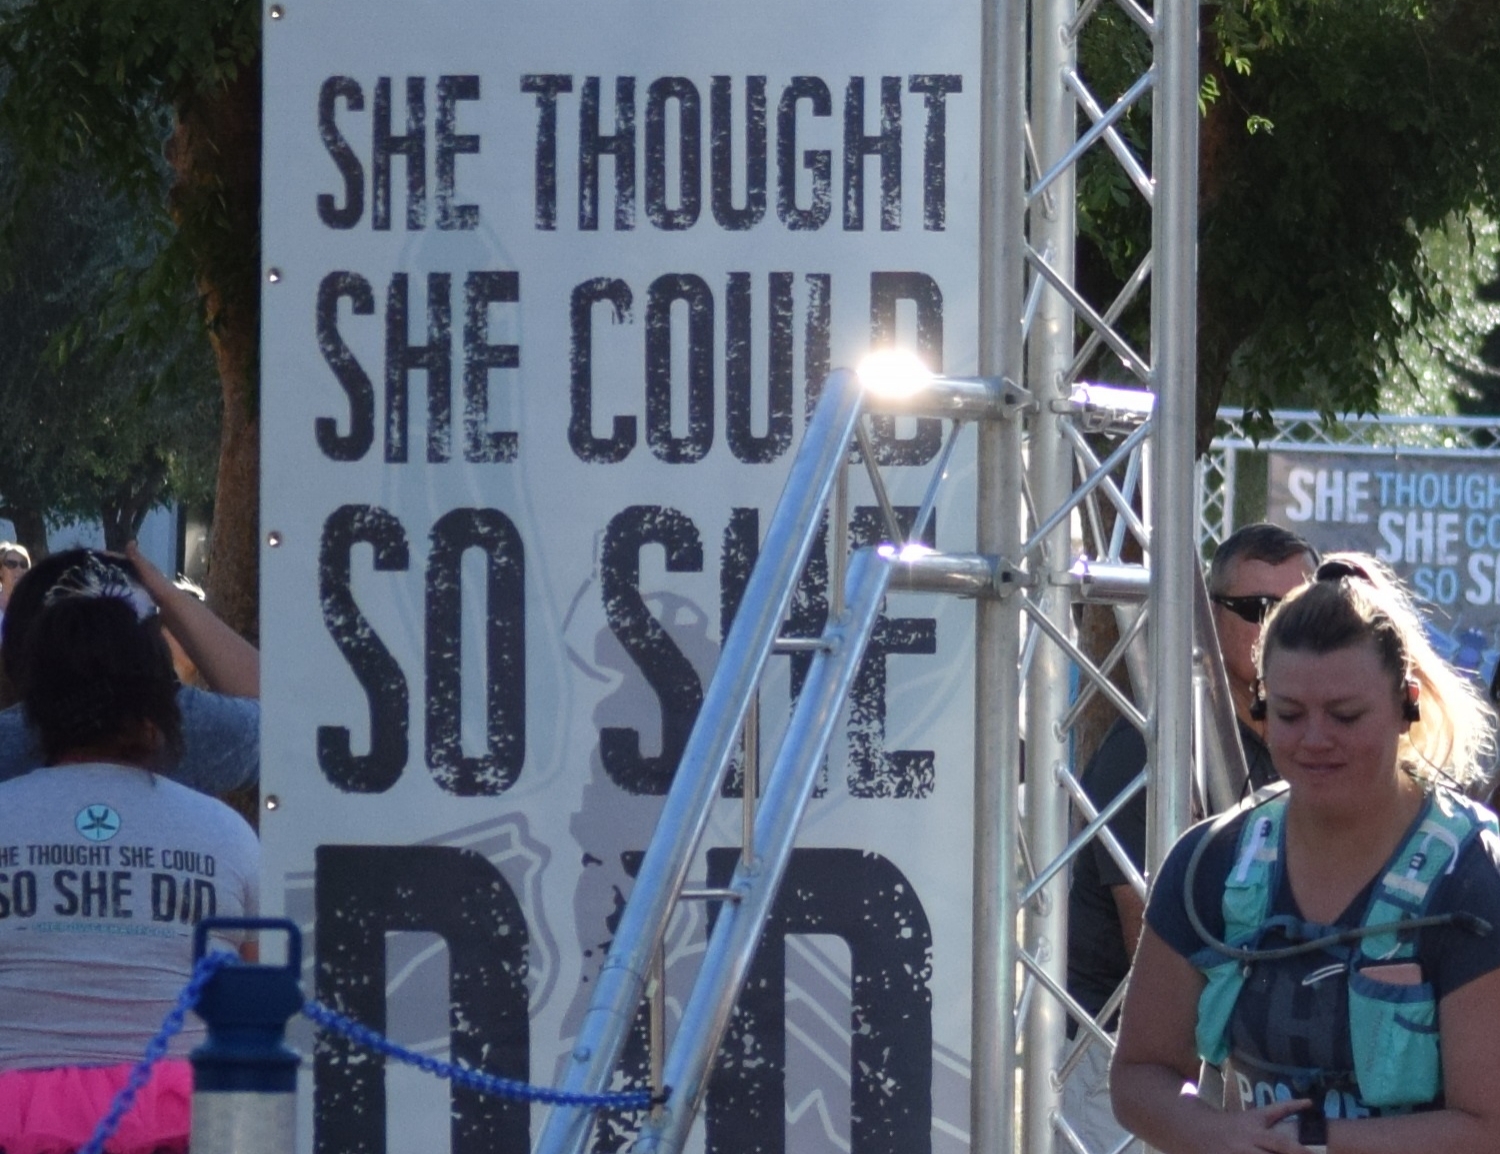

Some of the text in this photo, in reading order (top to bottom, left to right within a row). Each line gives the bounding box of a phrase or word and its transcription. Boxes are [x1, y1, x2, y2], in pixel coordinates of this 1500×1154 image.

[317, 74, 962, 232] SHE THOUGHT
[315, 271, 519, 464] SHE
[1285, 468, 1370, 523] SHE
[1375, 511, 1459, 565] SHE
[1413, 567, 1459, 603] SO
[317, 505, 526, 794] SO
[27, 845, 112, 866] THOUGHT
[119, 846, 154, 868] SHE
[162, 850, 215, 877] COULD
[53, 869, 133, 918] SHE
[152, 873, 216, 926] DID
